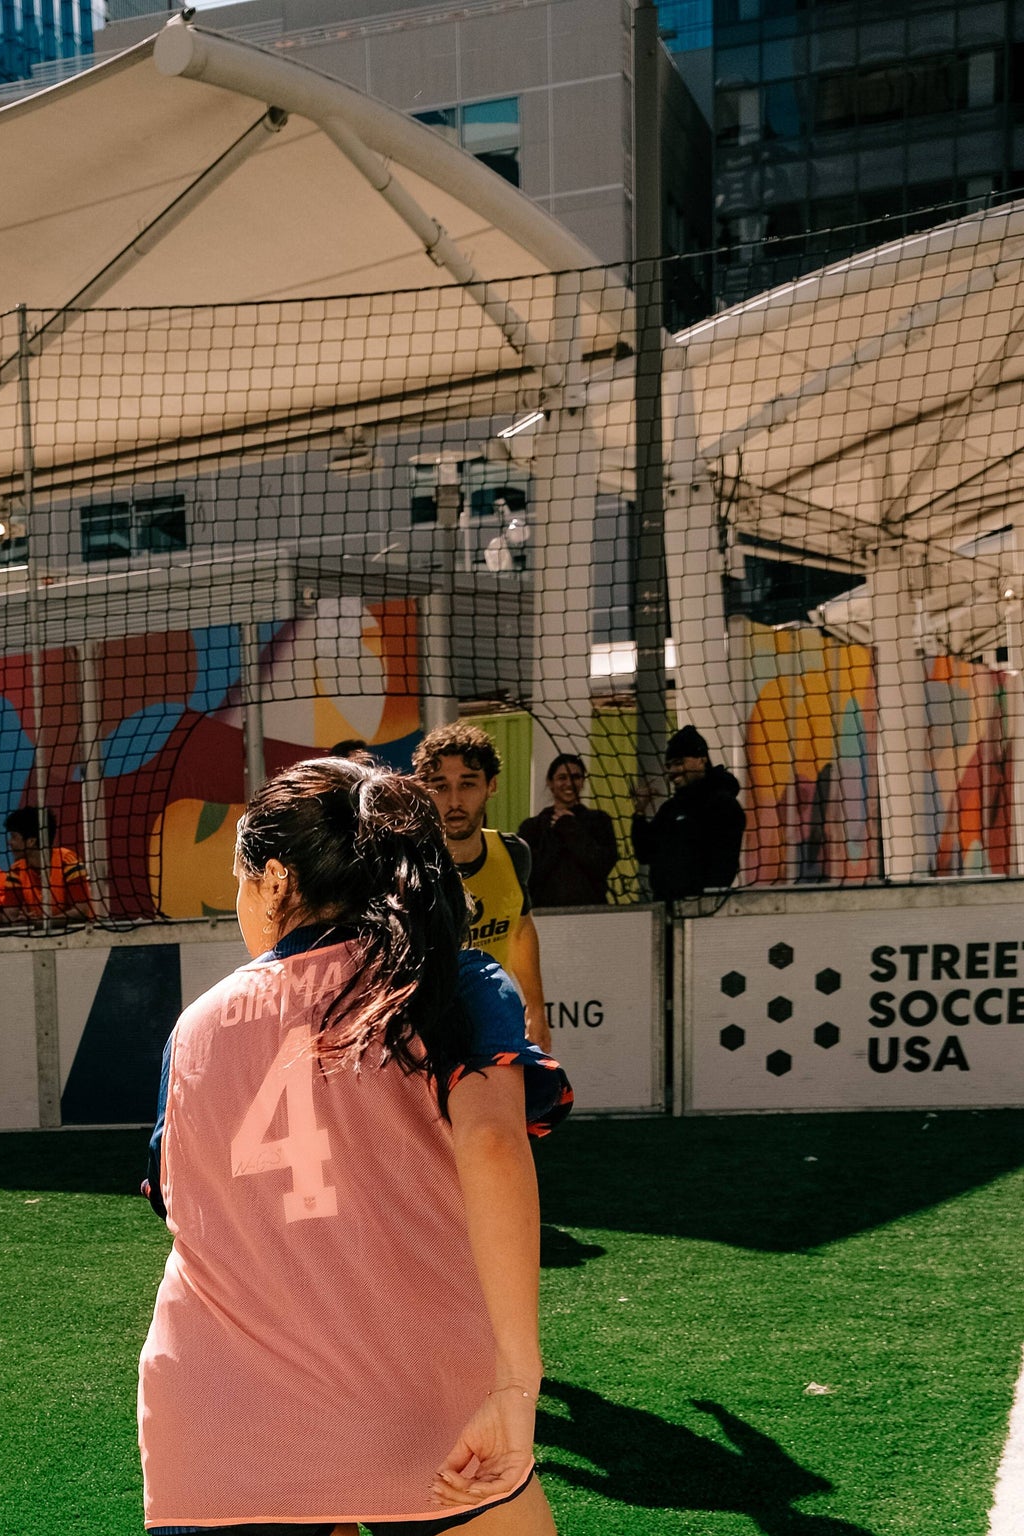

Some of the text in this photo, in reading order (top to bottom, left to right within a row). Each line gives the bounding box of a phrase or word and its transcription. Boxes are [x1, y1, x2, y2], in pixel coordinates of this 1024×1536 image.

[869, 941, 1024, 983] STREE
[220, 959, 343, 1027] GIRMA
[868, 1035, 970, 1073] USA
[231, 1024, 338, 1223] 4
